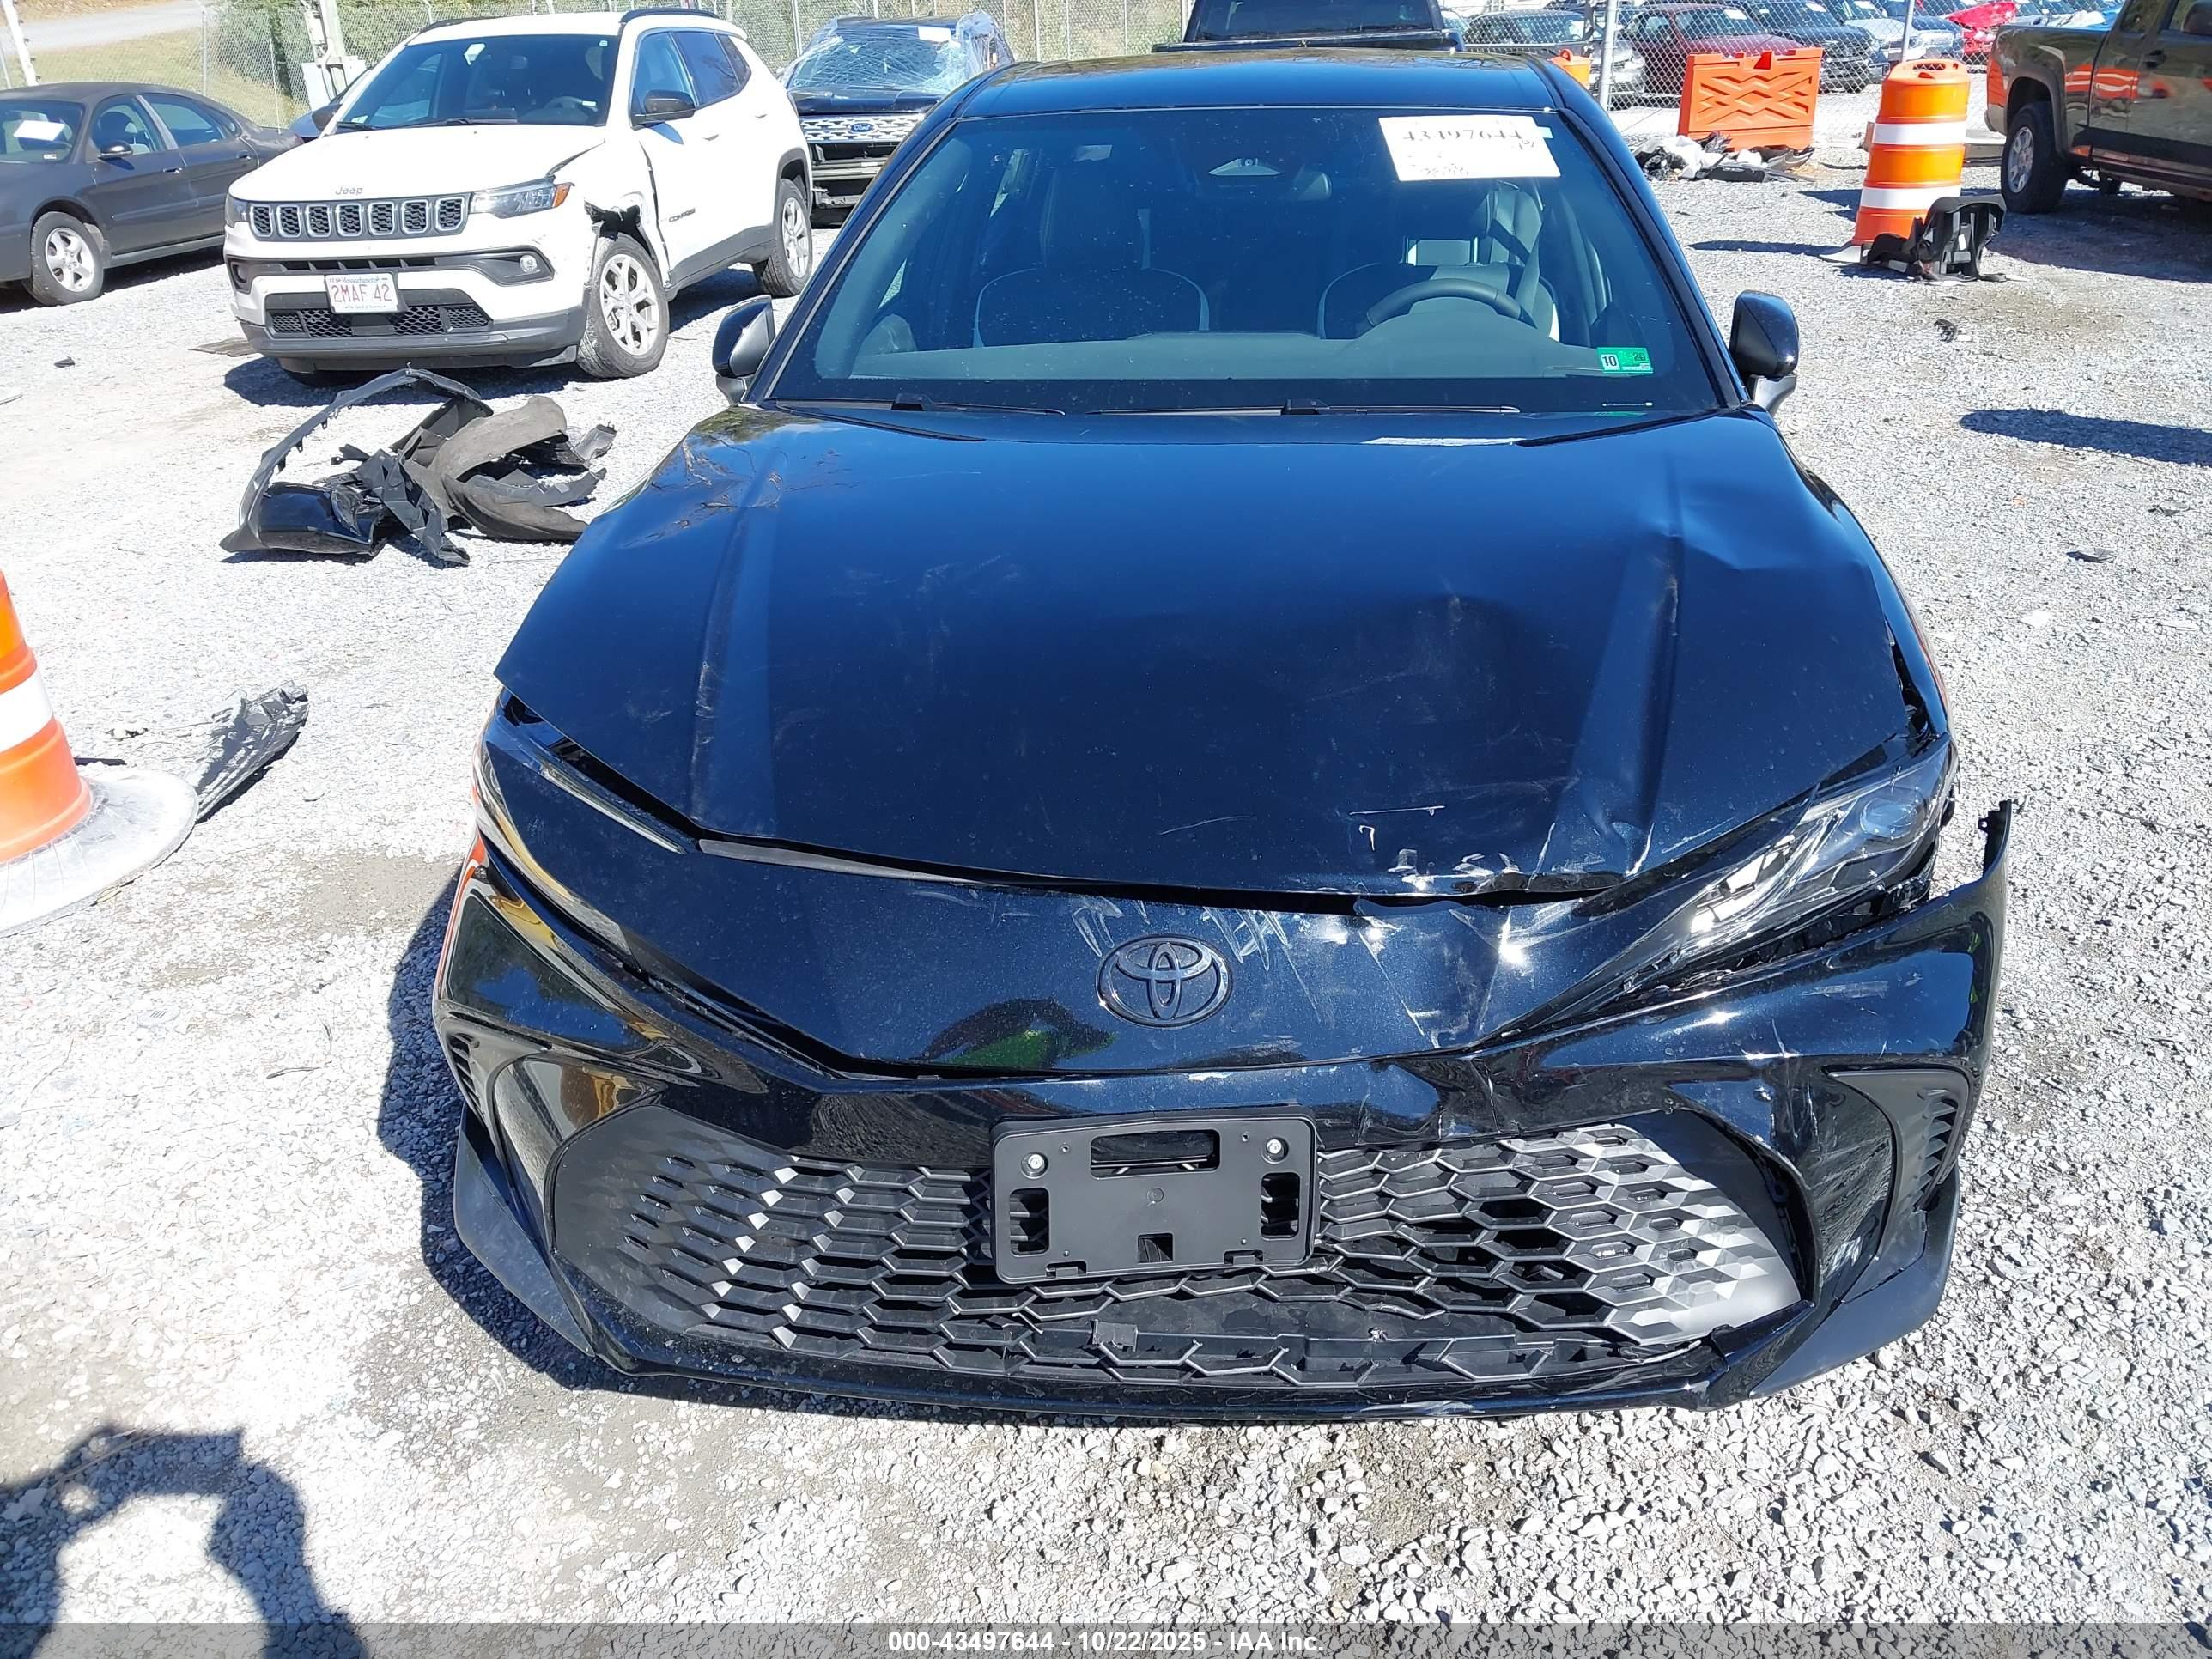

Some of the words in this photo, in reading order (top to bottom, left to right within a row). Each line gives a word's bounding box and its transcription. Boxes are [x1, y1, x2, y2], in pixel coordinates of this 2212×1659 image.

[335, 186, 363, 195] Jeep
[331, 283, 368, 303] 2MAF
[374, 283, 392, 302] 42
[1602, 356, 1618, 367] 10
